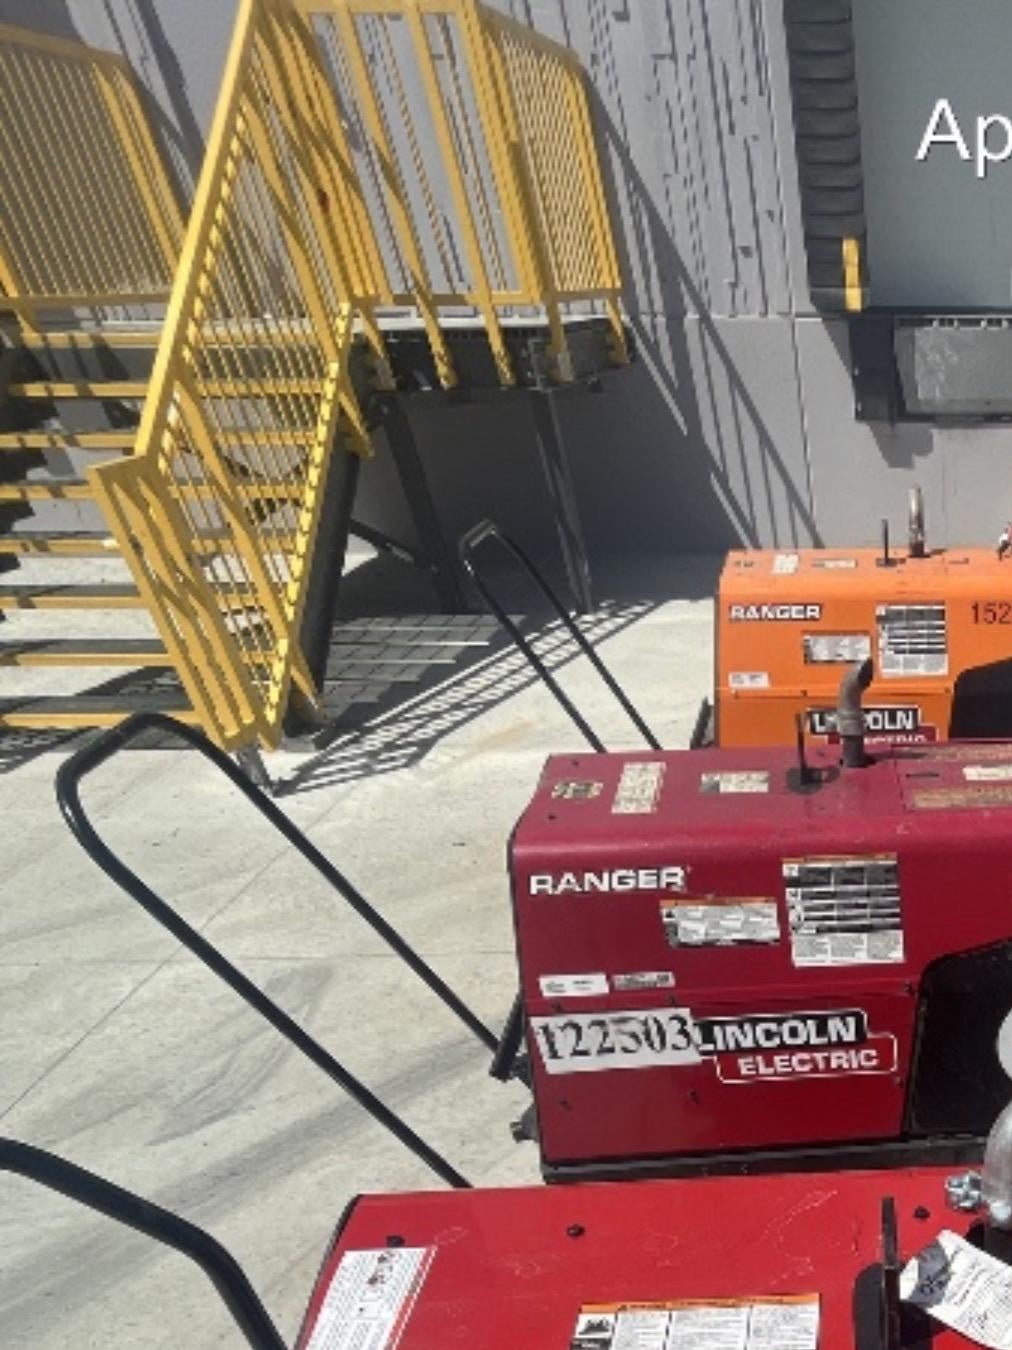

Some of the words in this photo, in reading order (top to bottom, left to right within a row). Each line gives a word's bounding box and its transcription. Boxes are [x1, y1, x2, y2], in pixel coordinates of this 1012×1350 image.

[730, 604, 821, 619] RANGER
[529, 866, 686, 895] RANGER
[538, 1013, 695, 1059] 122503
[692, 1016, 857, 1051] LINCOLN
[737, 1049, 879, 1076] ELECTRIC
